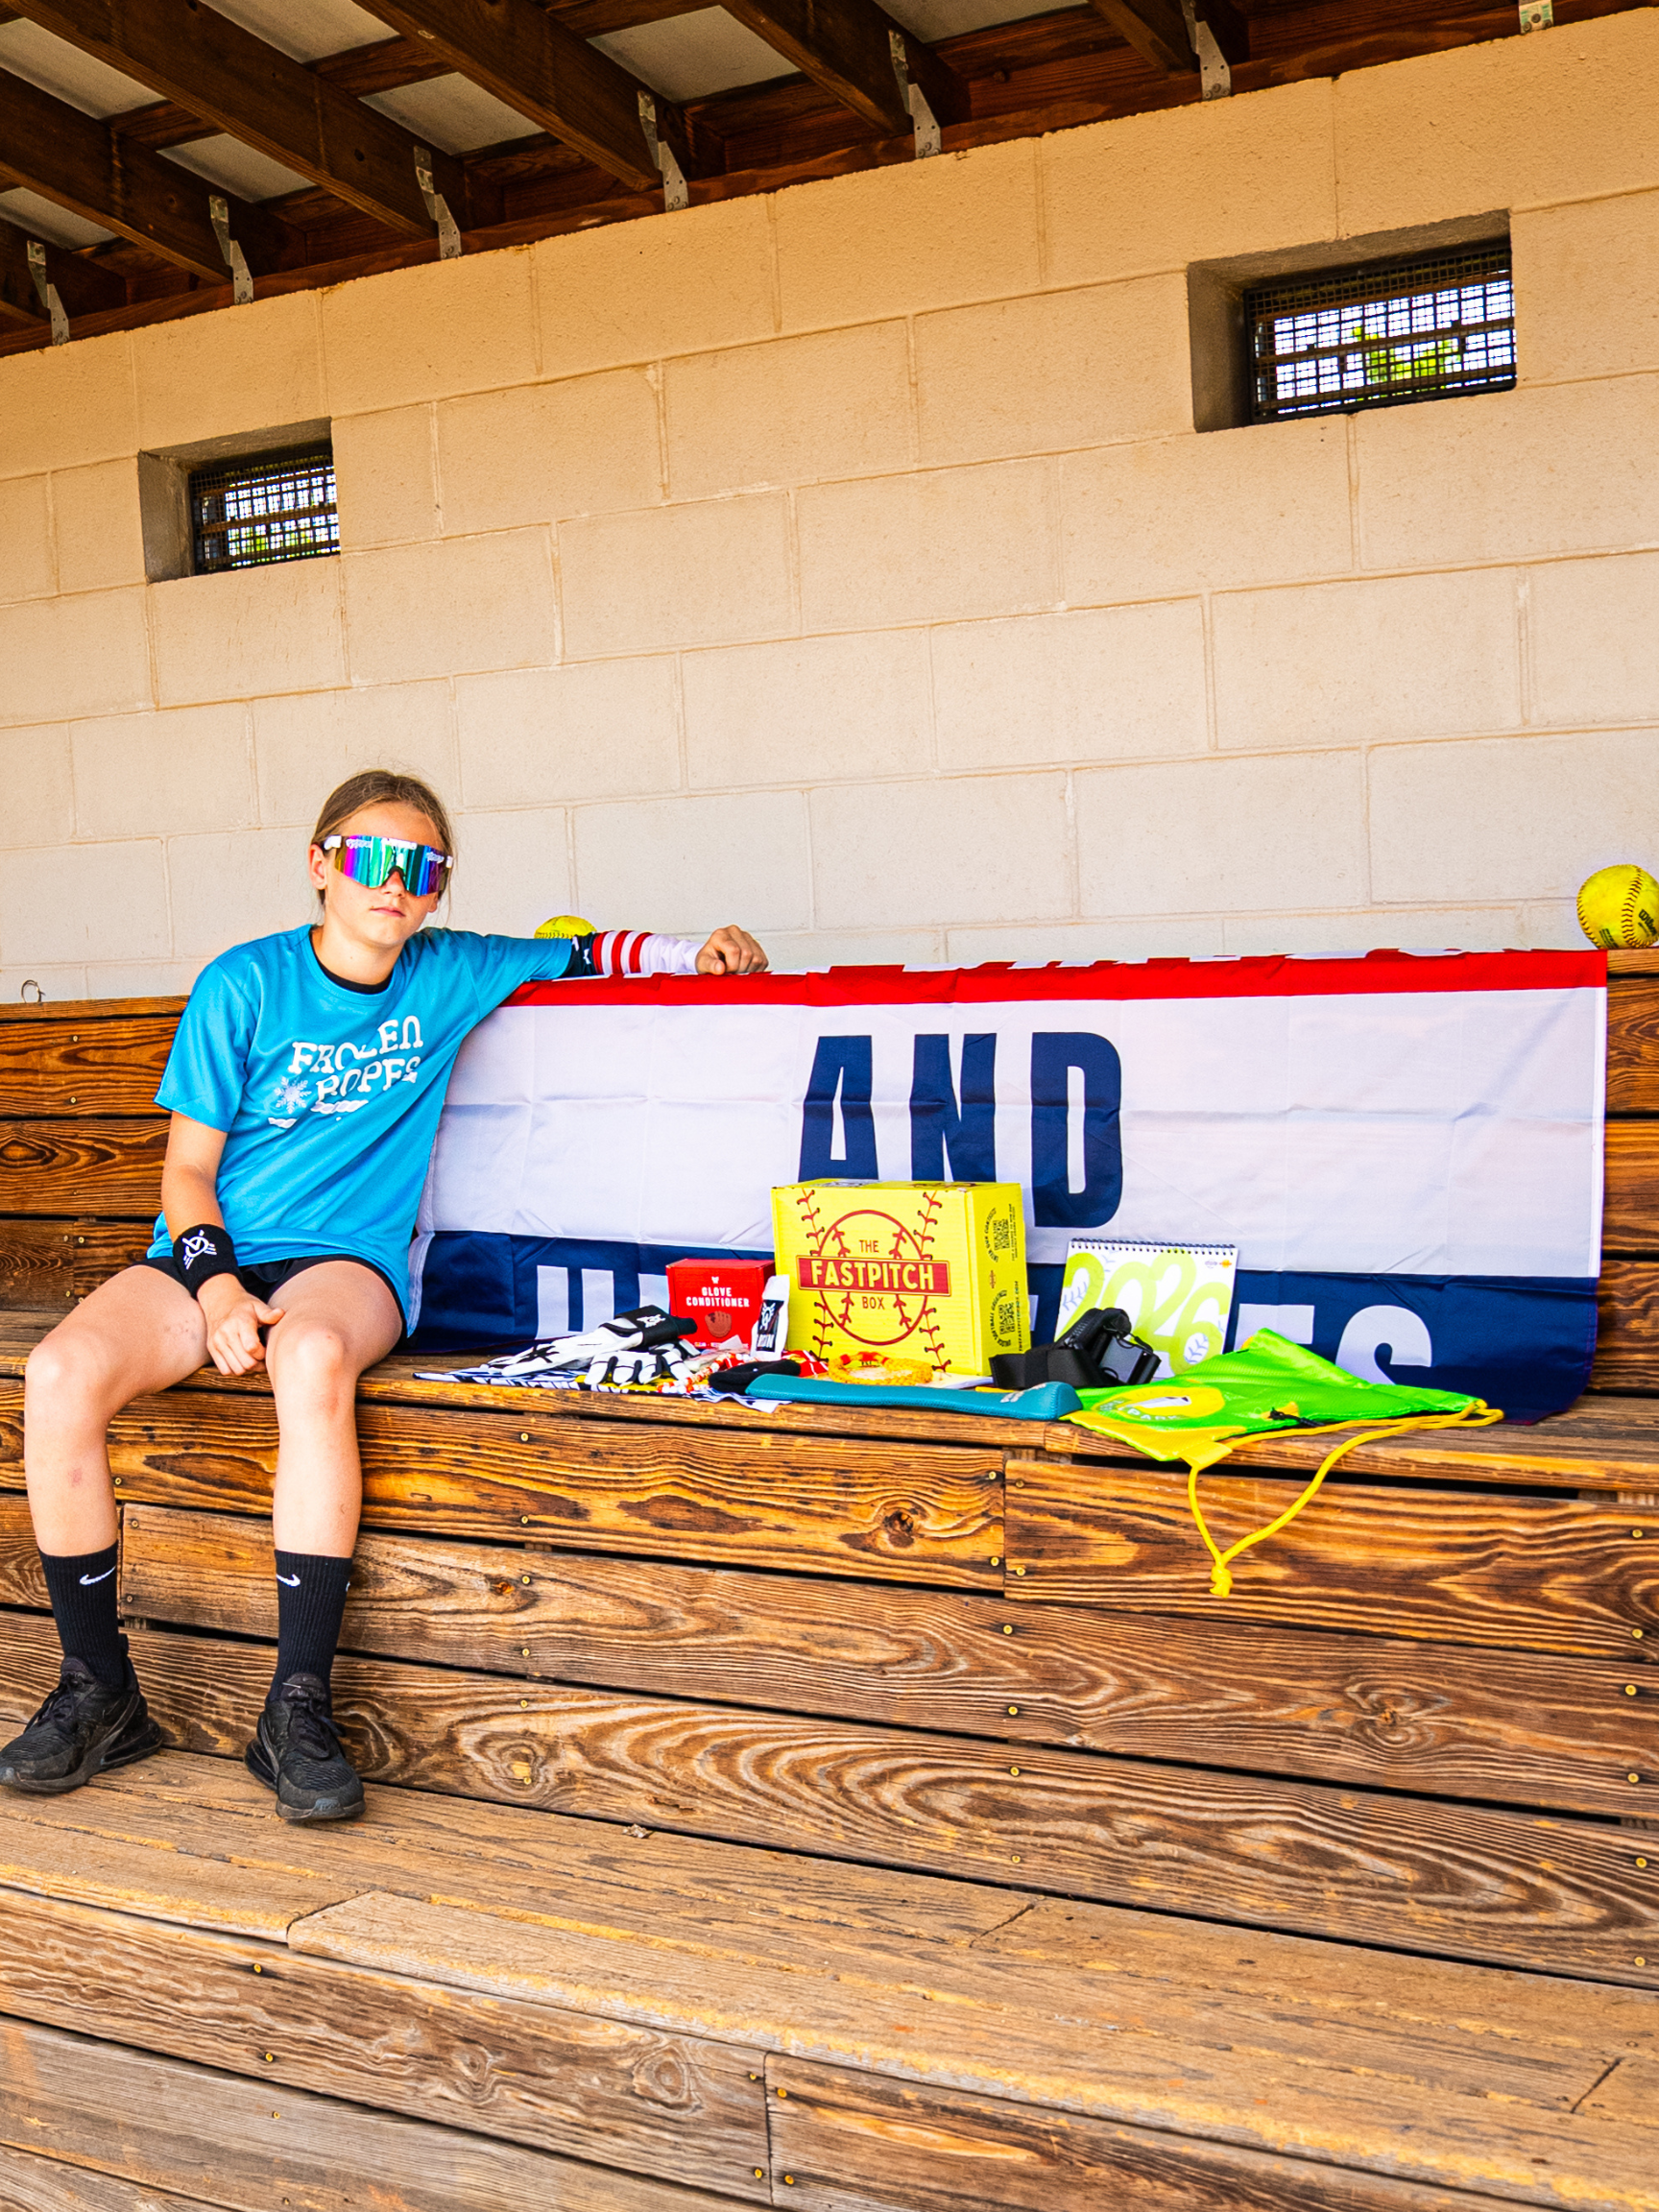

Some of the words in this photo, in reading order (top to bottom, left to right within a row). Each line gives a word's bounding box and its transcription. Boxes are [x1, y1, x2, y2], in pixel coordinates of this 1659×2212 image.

[798, 1031, 1122, 1228] AND
[858, 1239, 879, 1253] THE
[810, 1260, 935, 1290] FASTPITCH
[701, 1286, 733, 1297] GLOVE
[685, 1296, 750, 1308] CONDITIONER
[861, 1296, 885, 1310] BOX
[1054, 1248, 1232, 1377] 2026
